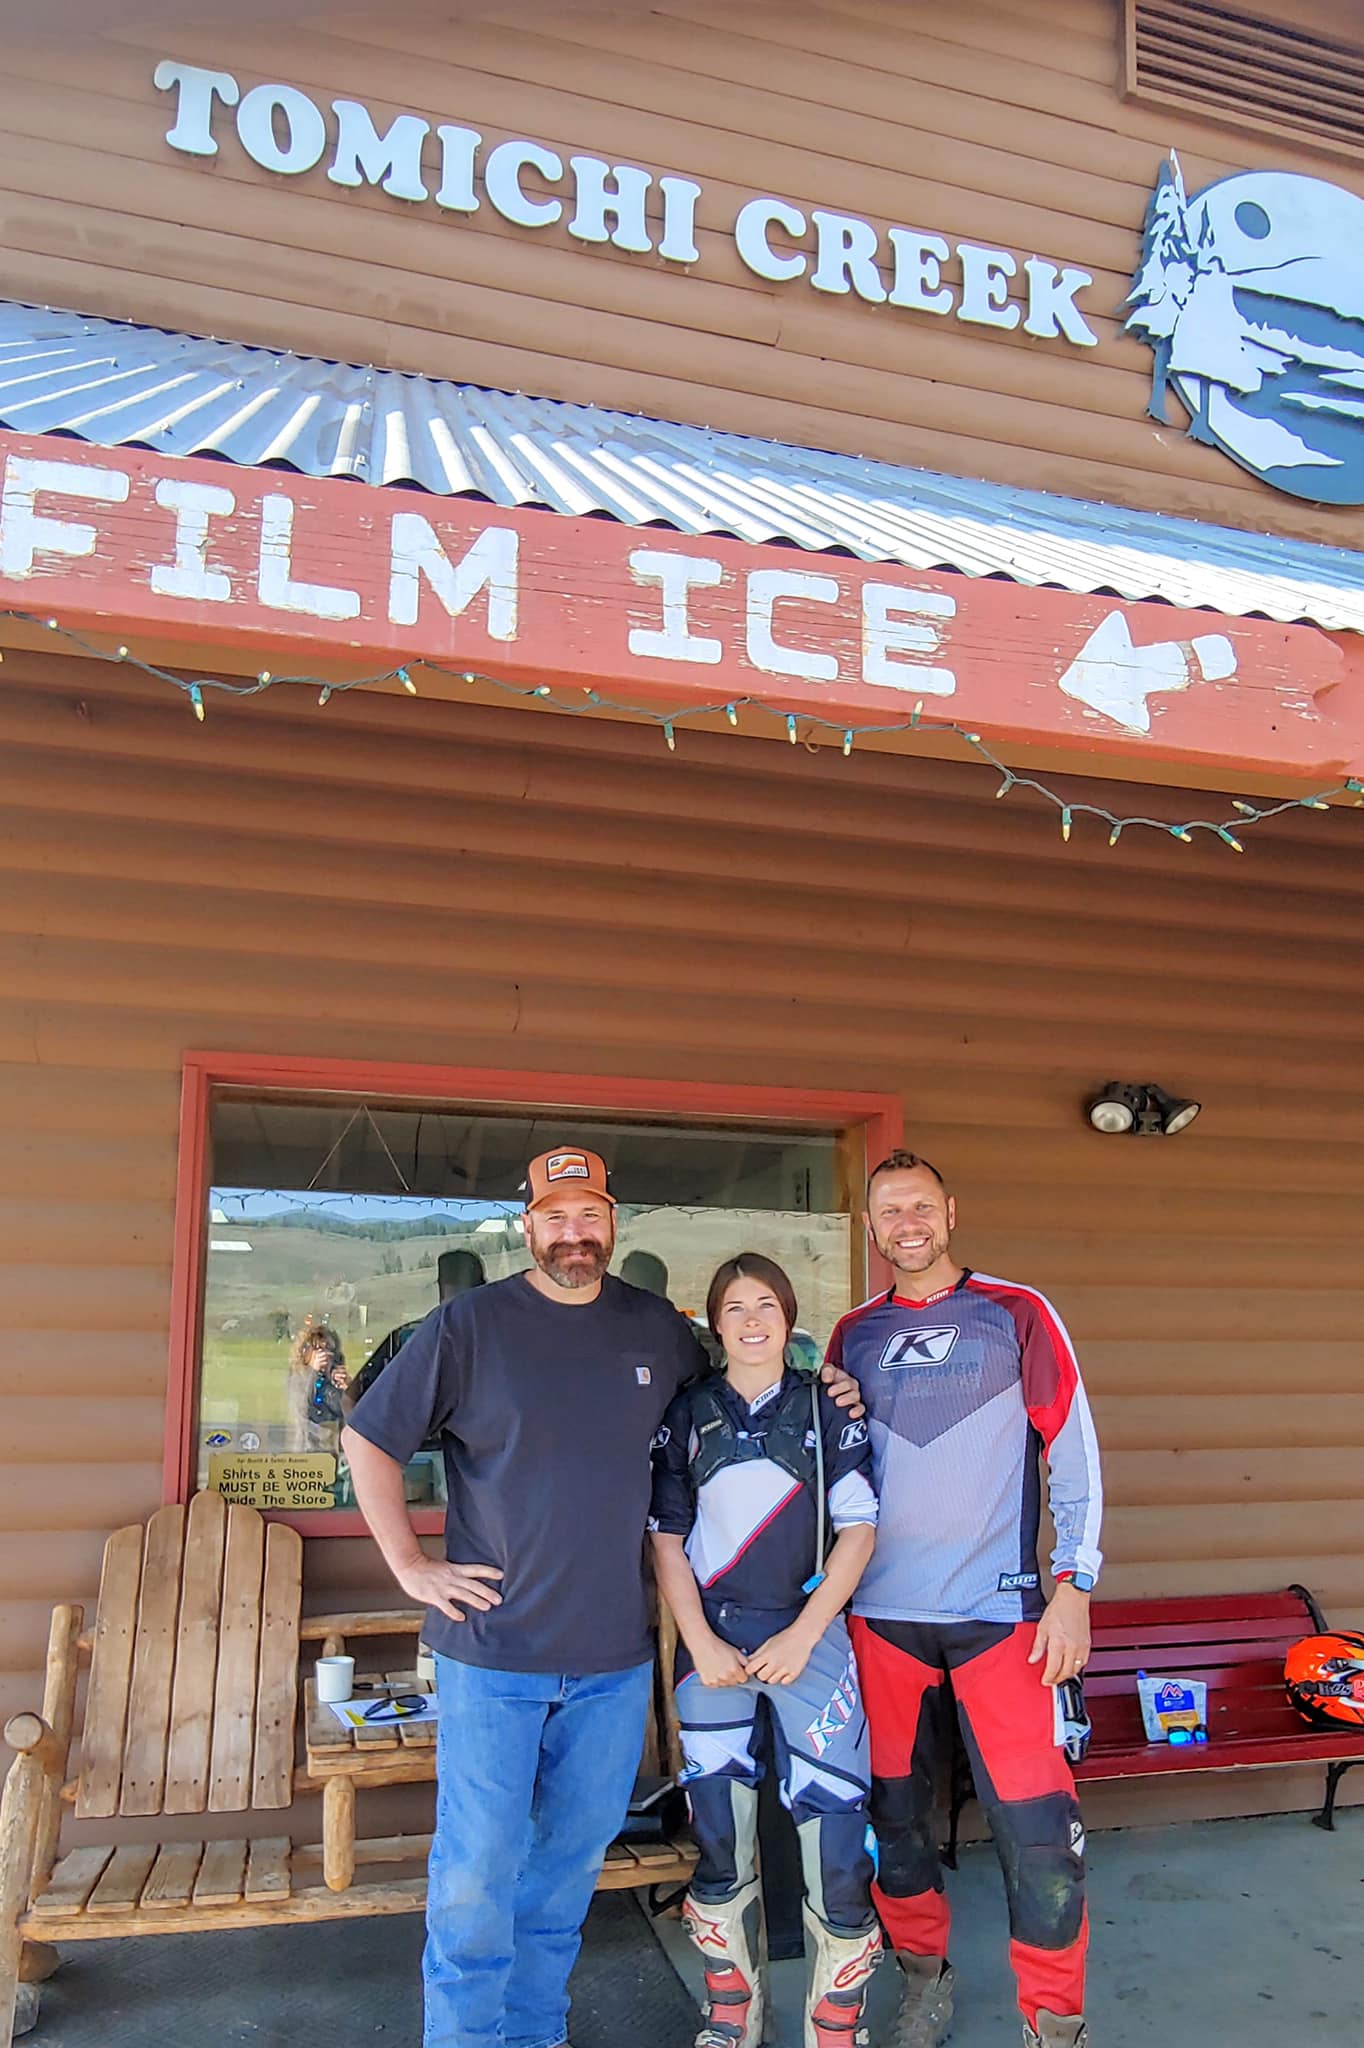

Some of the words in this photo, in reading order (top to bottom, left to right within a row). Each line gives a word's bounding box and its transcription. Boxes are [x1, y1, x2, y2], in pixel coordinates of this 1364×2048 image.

[154, 60, 702, 264] TOMICHI
[735, 198, 1098, 347] CREEK
[0, 453, 520, 642] FILM
[627, 549, 957, 696] ICE
[222, 1468, 261, 1480] Shirts
[267, 1468, 276, 1479] &
[283, 1468, 324, 1479] Shoes
[218, 1481, 257, 1493] MUST
[262, 1481, 281, 1492] BE
[286, 1481, 327, 1492] WORN
[262, 1495, 286, 1505] The
[291, 1494, 327, 1505] Store
